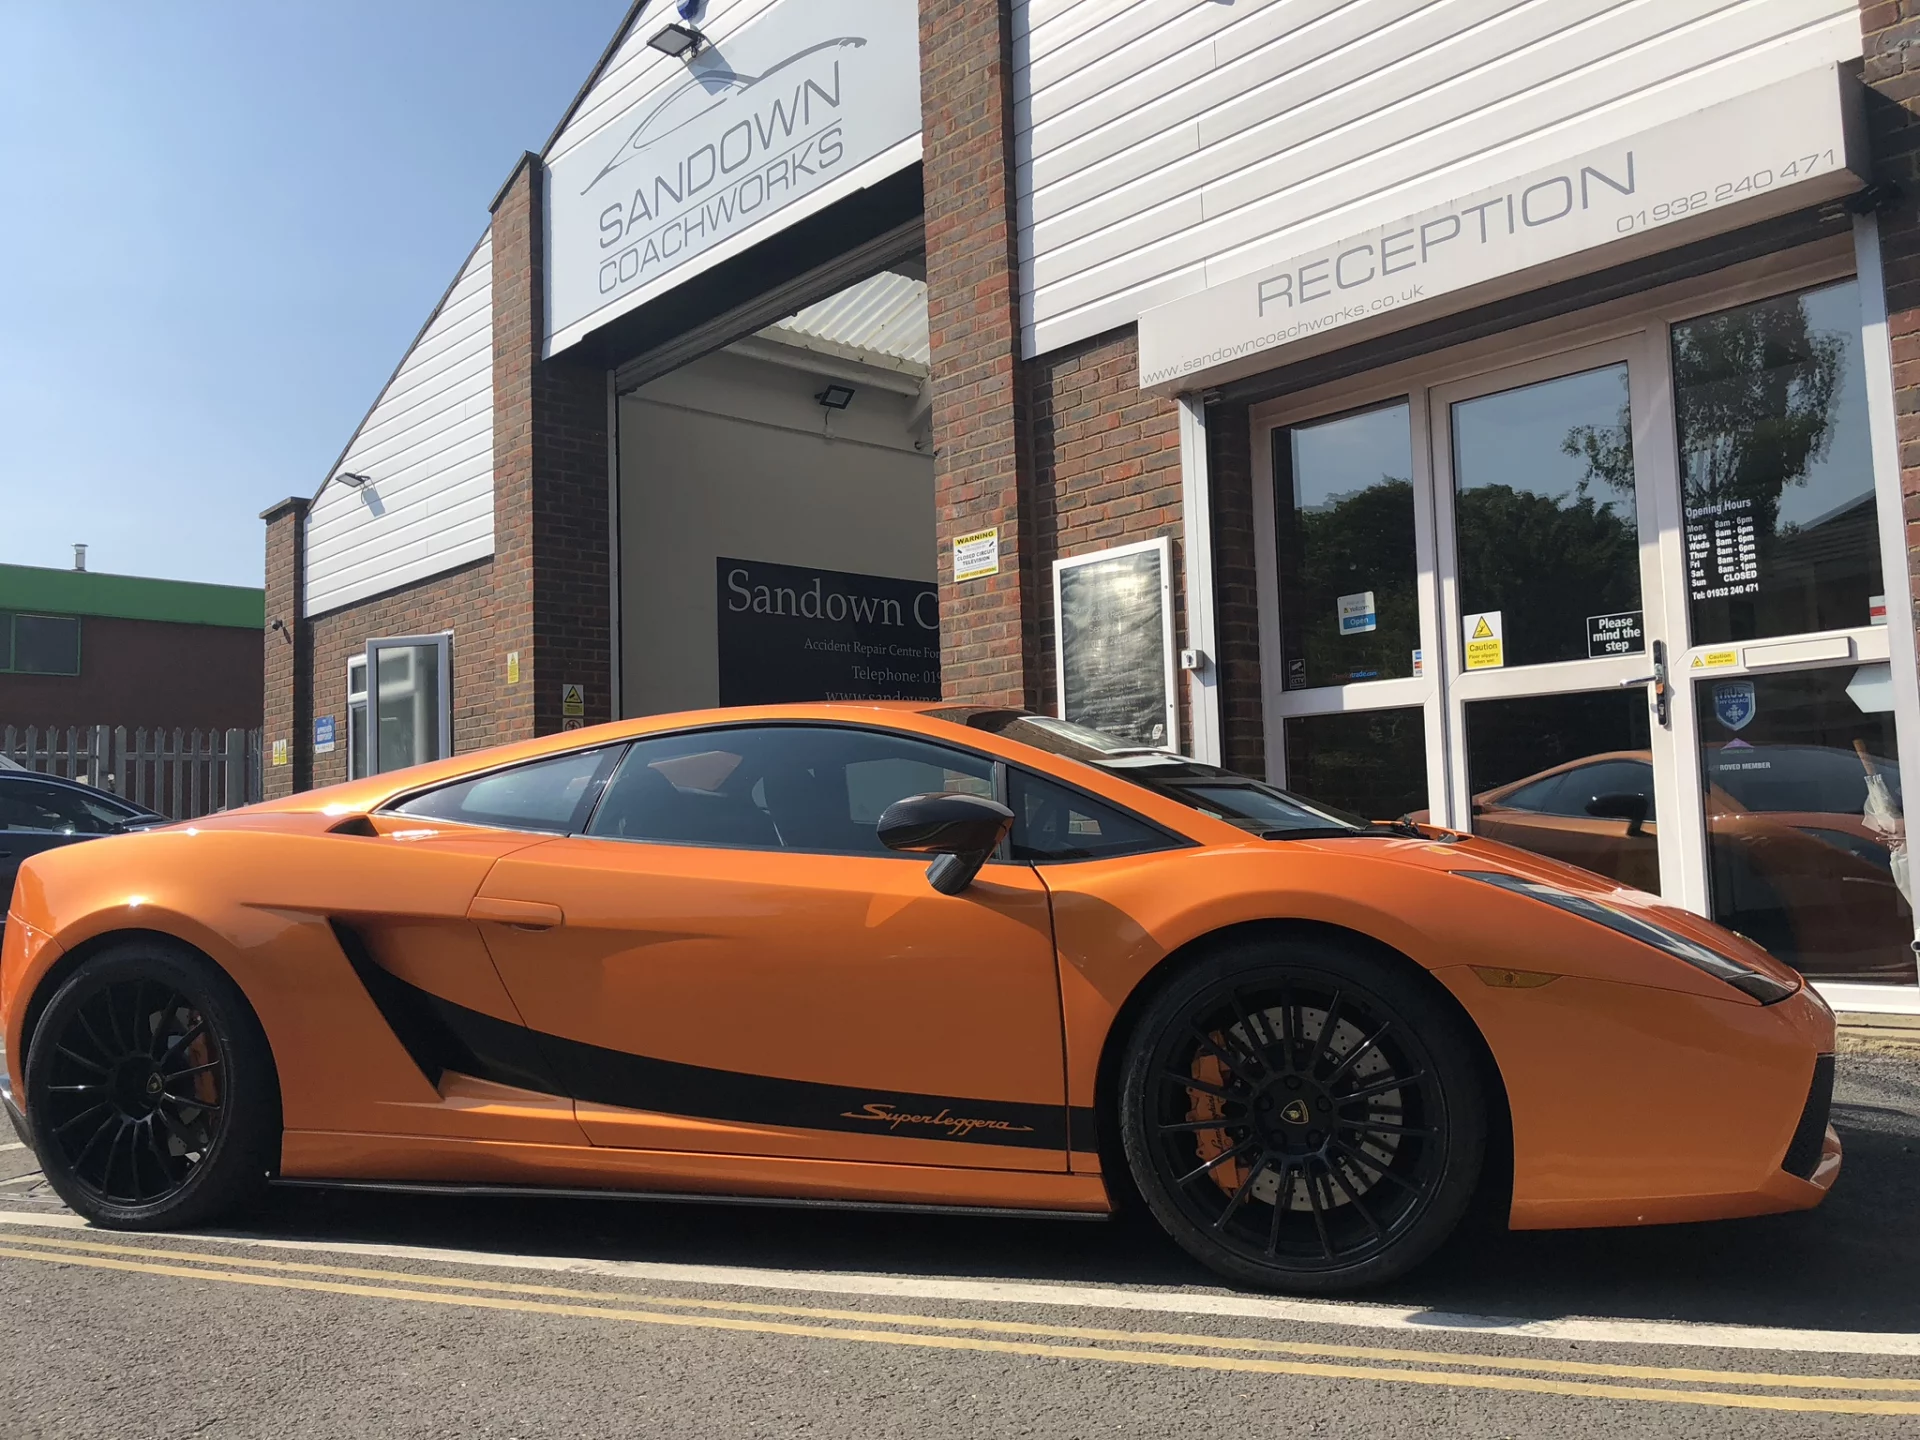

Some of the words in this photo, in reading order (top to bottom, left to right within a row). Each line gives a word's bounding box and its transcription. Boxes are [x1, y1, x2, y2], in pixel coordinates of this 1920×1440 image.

[600, 60, 840, 249] SANDOWN
[1616, 191, 1708, 233] 01932
[1714, 169, 1773, 203] 240
[1780, 149, 1835, 179] 471
[599, 127, 844, 294] COACHWORKS
[1257, 151, 1635, 317] RECEPTION
[1142, 284, 1424, 385] www.sandowncoachworks.co.uk
[1685, 504, 1722, 519] Opening
[1724, 499, 1751, 511] Hours
[1687, 525, 1703, 533] Mon
[1714, 520, 1730, 528] 8am
[1736, 516, 1753, 525] 6pm
[957, 531, 994, 545] WARNING
[1688, 533, 1707, 541] Tues
[1715, 529, 1731, 537] 8am
[1737, 526, 1753, 534] 6pm
[1689, 541, 1710, 550] Weds
[1716, 538, 1732, 546] 8am
[1738, 535, 1754, 544] 6pm
[957, 553, 975, 562] CLOSED
[976, 548, 995, 557] CIRCUIT
[1690, 551, 1708, 560] Thur
[1717, 547, 1733, 555] 8am
[1739, 544, 1755, 553] 6pm
[1717, 556, 1733, 564] 8am
[1739, 553, 1756, 562] 5pm
[963, 556, 990, 565] TELEVISION
[1691, 569, 1704, 577] Sat
[1718, 565, 1734, 573] 8am
[1740, 562, 1756, 571] 1pm
[1692, 579, 1706, 587] Sun
[1723, 570, 1757, 582] CLOSED
[727, 568, 904, 627] Sandown
[1692, 591, 1705, 600] Tel:
[1707, 587, 1729, 598] 01932
[1730, 585, 1744, 595] 240
[1745, 583, 1759, 592] 471
[1350, 617, 1368, 626] Open
[1598, 617, 1633, 630] Please
[1593, 628, 1620, 642] mind
[1622, 627, 1641, 638] the
[804, 638, 851, 653] Accident
[853, 641, 887, 657] Repair
[889, 644, 921, 658] Centre
[1469, 643, 1497, 652] Caution
[1605, 641, 1629, 653] step
[852, 665, 920, 684] Telephone:
[1742, 762, 1771, 770] MEMBER
[840, 1103, 1034, 1135] Superleggera
